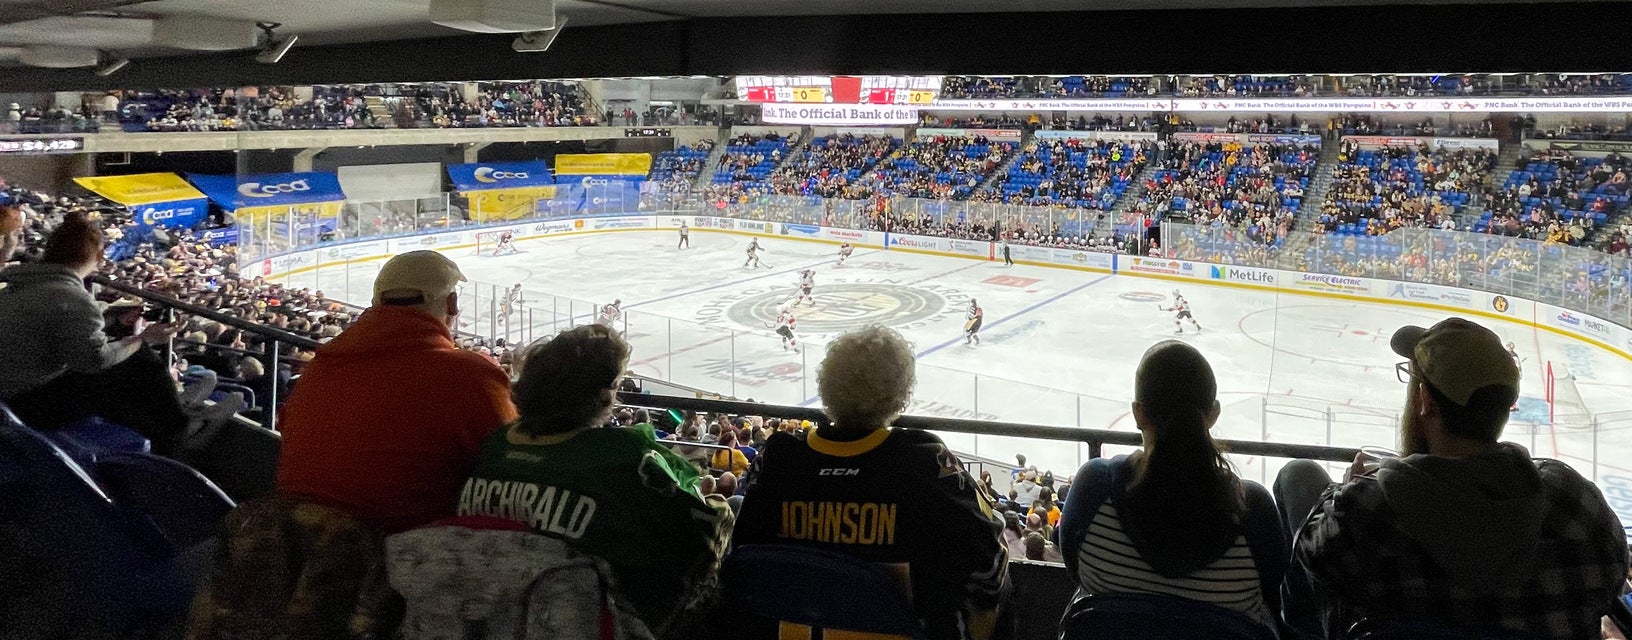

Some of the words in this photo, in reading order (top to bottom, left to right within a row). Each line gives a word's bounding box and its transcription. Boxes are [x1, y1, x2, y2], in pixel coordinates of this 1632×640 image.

[778, 108, 797, 118] The
[800, 108, 846, 119] Official
[850, 109, 881, 119] Bank
[884, 109, 894, 119] of
[896, 109, 908, 119] the
[1229, 268, 1274, 283] MetLife
[818, 467, 861, 477] CCM
[458, 477, 597, 540] ARCHIBALD
[779, 501, 897, 545] JOHNSON
